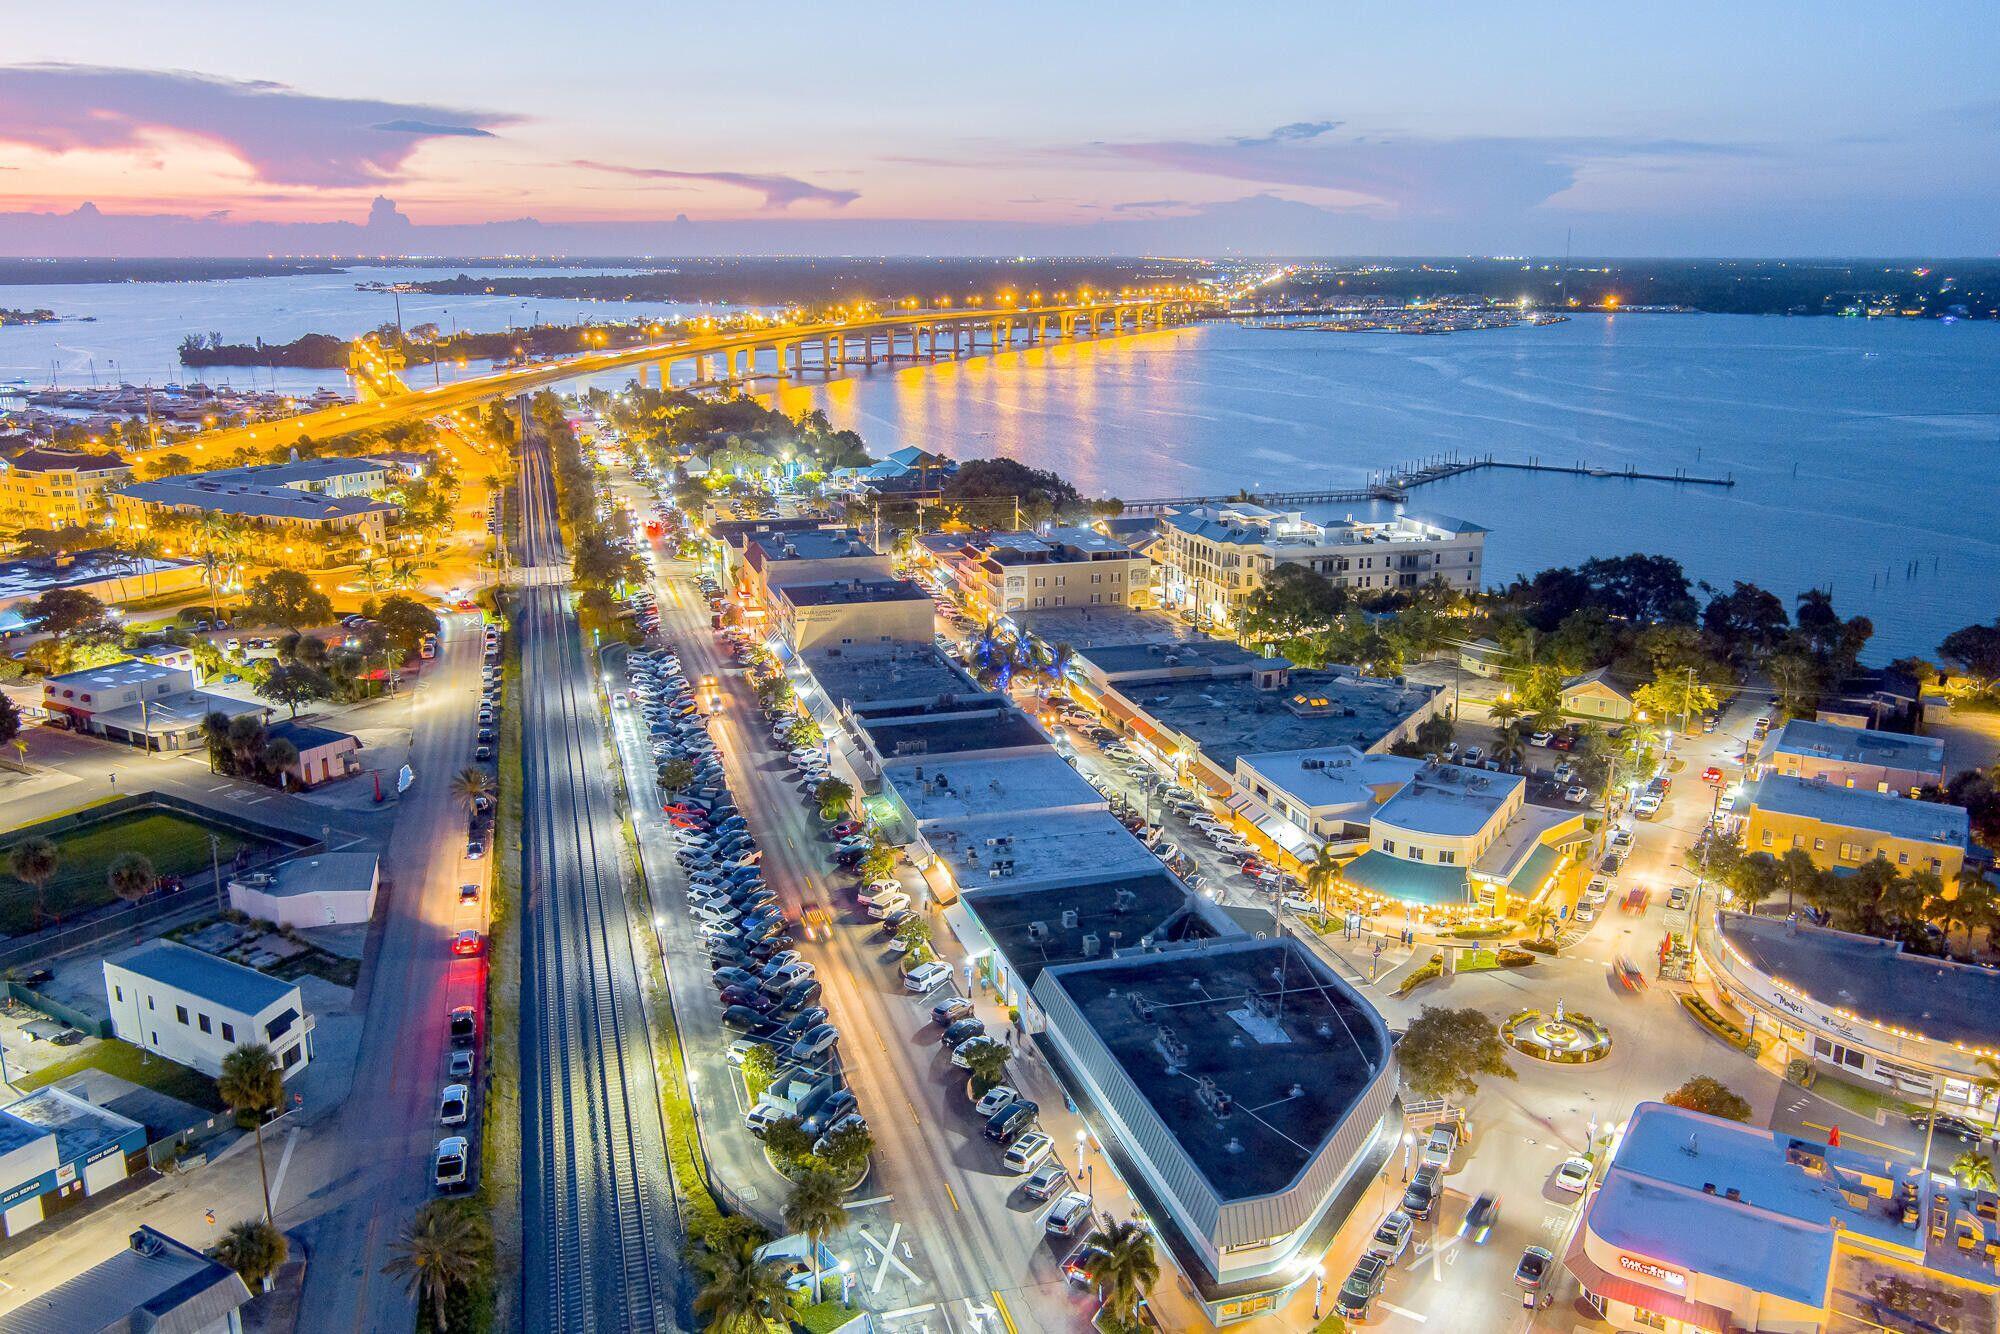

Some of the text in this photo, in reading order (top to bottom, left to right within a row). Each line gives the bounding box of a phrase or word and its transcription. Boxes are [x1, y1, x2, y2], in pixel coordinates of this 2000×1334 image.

[87, 1144, 119, 1163] BODY SHOP
[3, 1182, 40, 1203] AUTO REPAIR
[1620, 1256, 1641, 1270] OAK
